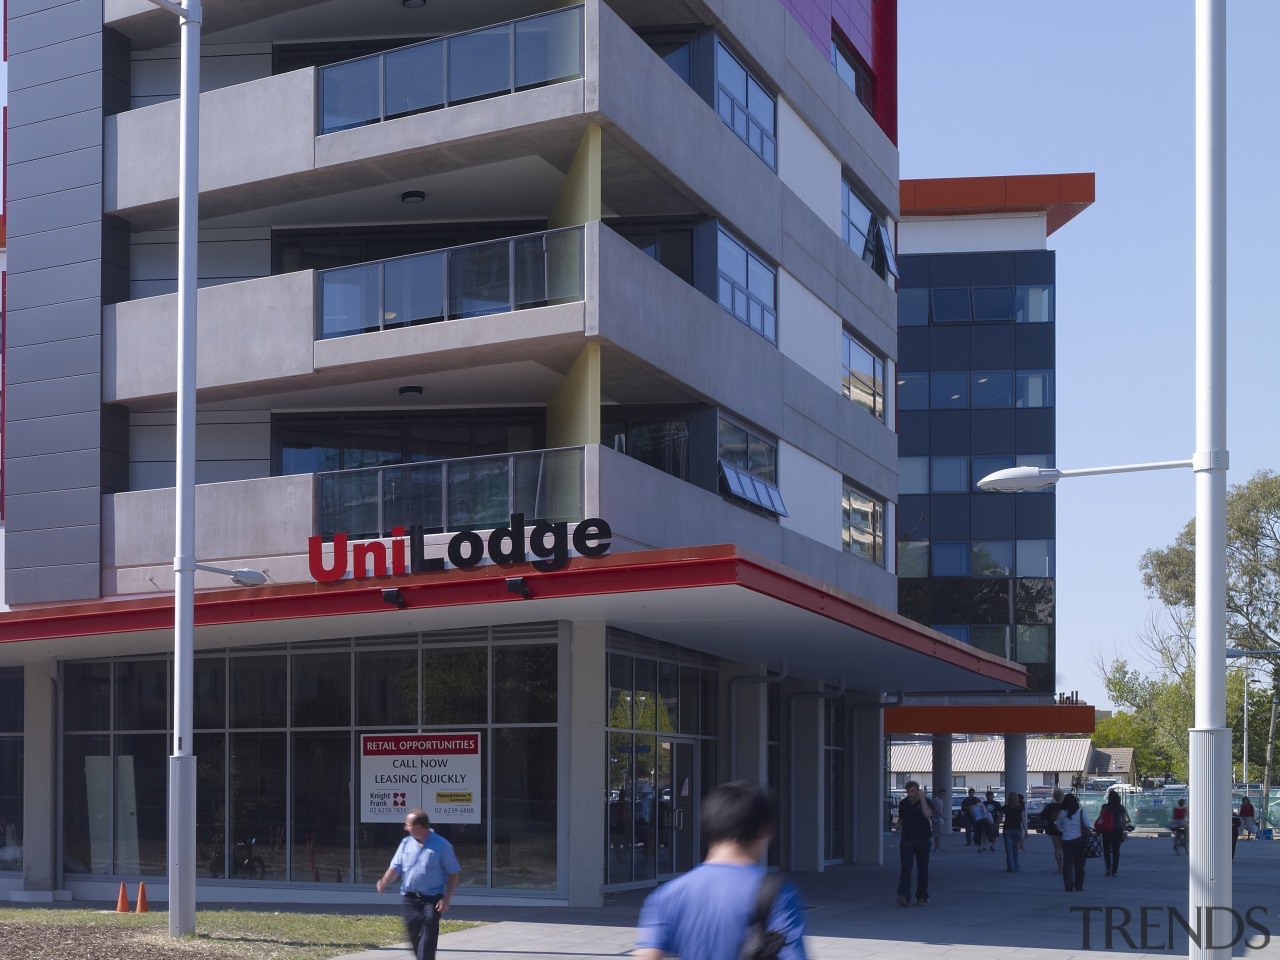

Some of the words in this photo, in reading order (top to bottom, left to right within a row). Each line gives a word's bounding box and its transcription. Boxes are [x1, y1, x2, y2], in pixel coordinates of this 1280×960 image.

[308, 512, 612, 583] UniLodge
[367, 741, 397, 750] RETAIL
[399, 740, 475, 750] OPPORTUNITIES
[392, 759, 417, 768] CALL
[421, 759, 448, 768] NOW
[375, 775, 418, 784] LEASING
[421, 774, 467, 785] QUICKLY
[370, 792, 391, 801] Knight
[370, 799, 388, 807] Frank
